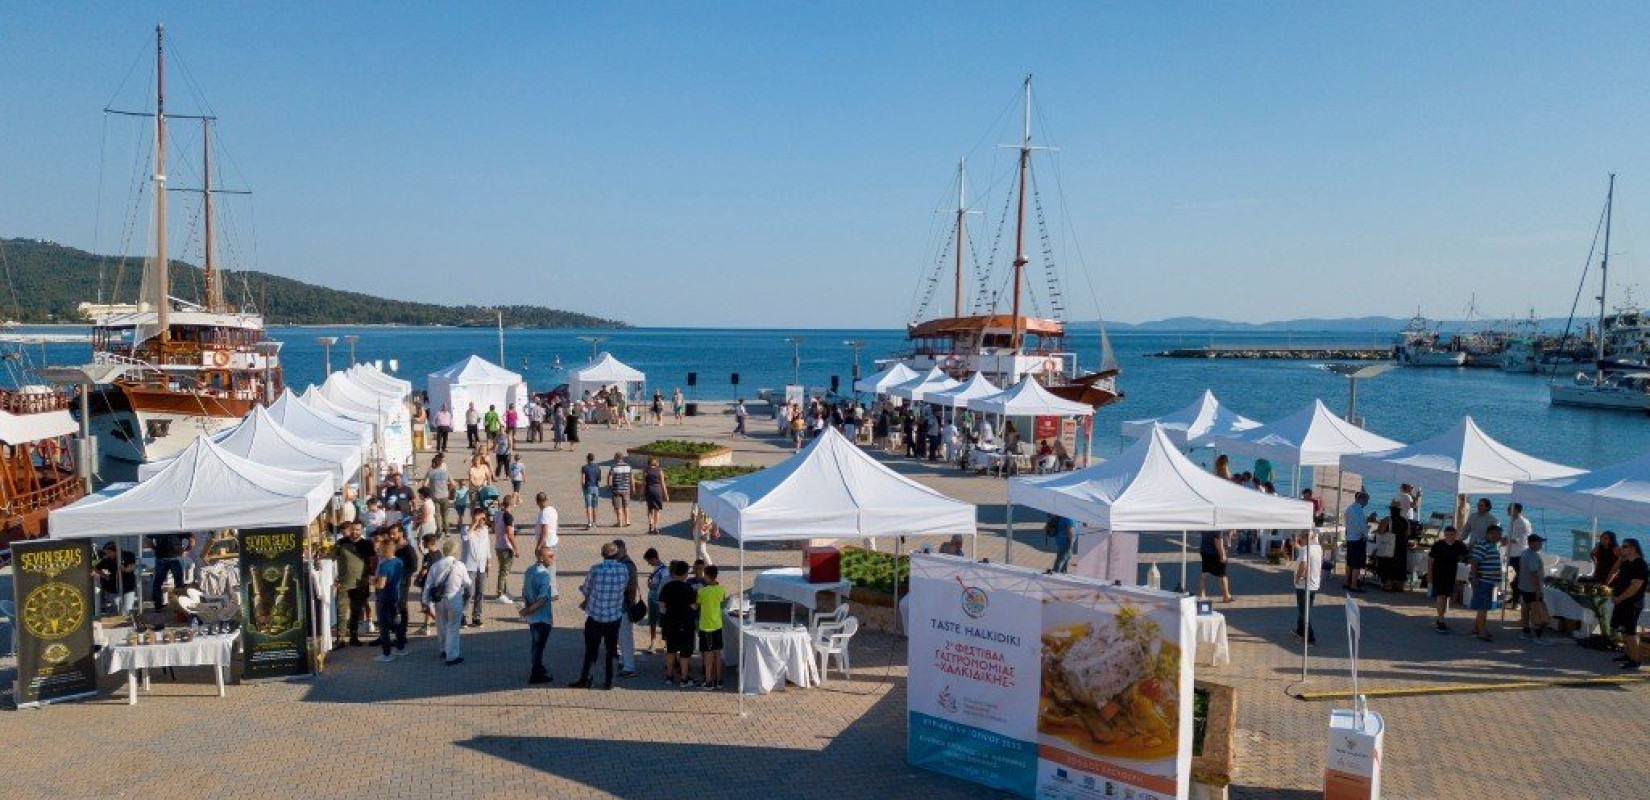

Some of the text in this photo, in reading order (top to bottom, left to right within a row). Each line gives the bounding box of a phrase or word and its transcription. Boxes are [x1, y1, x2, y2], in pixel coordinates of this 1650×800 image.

[245, 533, 296, 551] SEVEN SEALS
[21, 551, 52, 570] SEVEN
[54, 547, 82, 565] SEALS
[931, 618, 1021, 647] TASTE HALKIDIKI
[935, 649, 1016, 678] ΓΑΣΤΡΟΝΟΜΙΑΣ
[955, 642, 1005, 662] ΦΕΣΤΙΒΑΛ
